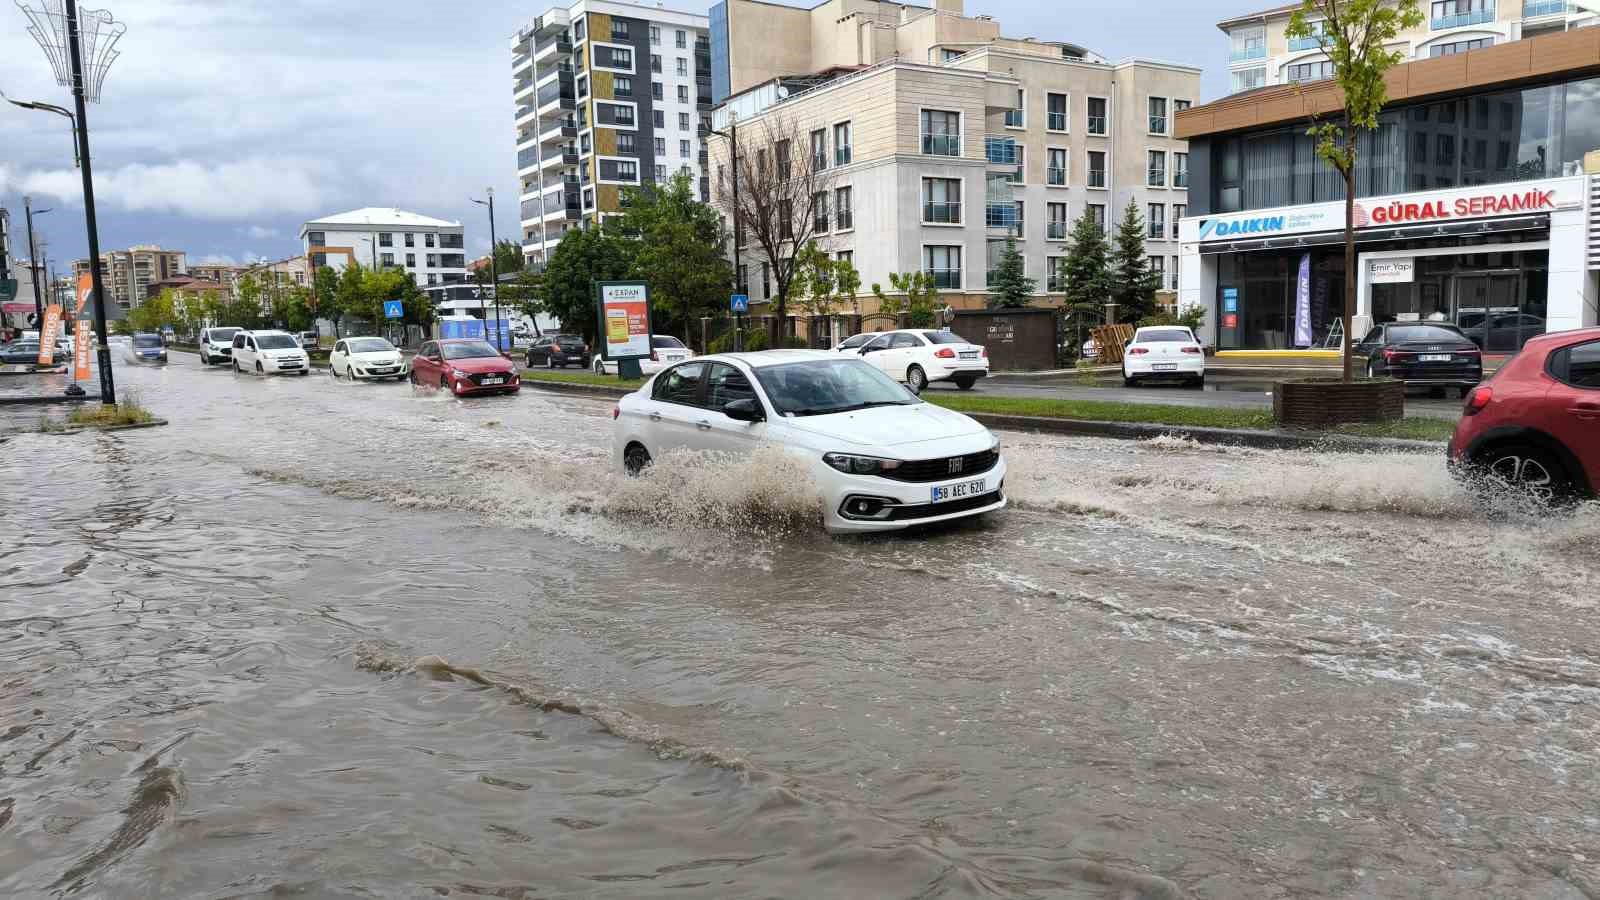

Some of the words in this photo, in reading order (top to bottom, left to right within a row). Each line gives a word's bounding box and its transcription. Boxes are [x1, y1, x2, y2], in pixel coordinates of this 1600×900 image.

[1372, 200, 1449, 223] GÜRAL
[1454, 189, 1555, 216] SERAMİK
[1216, 216, 1284, 236] DAIKIN
[1301, 278, 1309, 329] DAIKIN
[43, 313, 57, 358] MIGROS
[948, 457, 963, 473] FIAT
[938, 487, 949, 499] 58
[953, 484, 967, 497] AEC
[970, 481, 984, 494] 620
